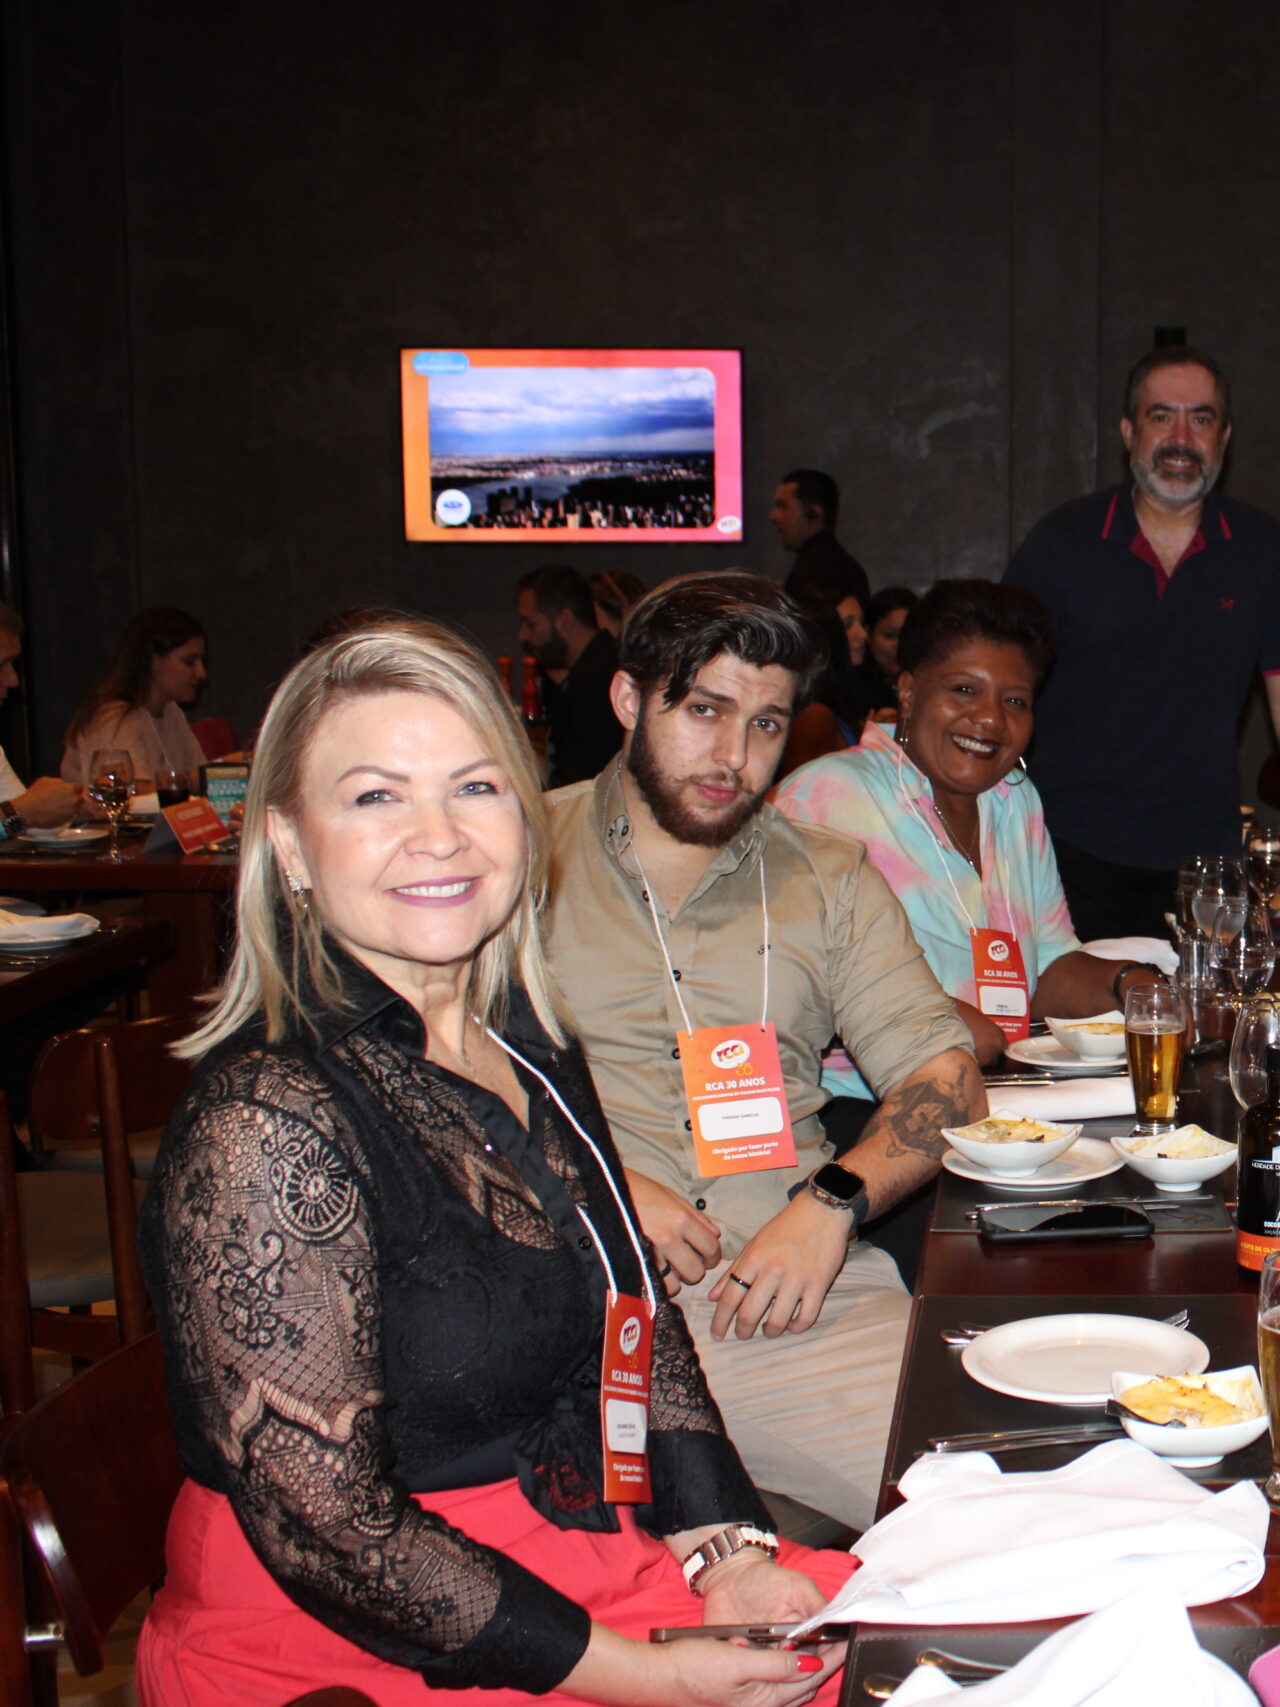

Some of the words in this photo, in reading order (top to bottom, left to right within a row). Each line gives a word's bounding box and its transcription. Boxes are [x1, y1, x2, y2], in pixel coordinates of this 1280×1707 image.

[705, 1081, 725, 1092] RCA
[726, 1080, 738, 1089] 30
[739, 1077, 766, 1088] ANOS
[611, 1369, 622, 1382] RCA
[622, 1371, 629, 1383] 30
[629, 1372, 643, 1386] ANOS
